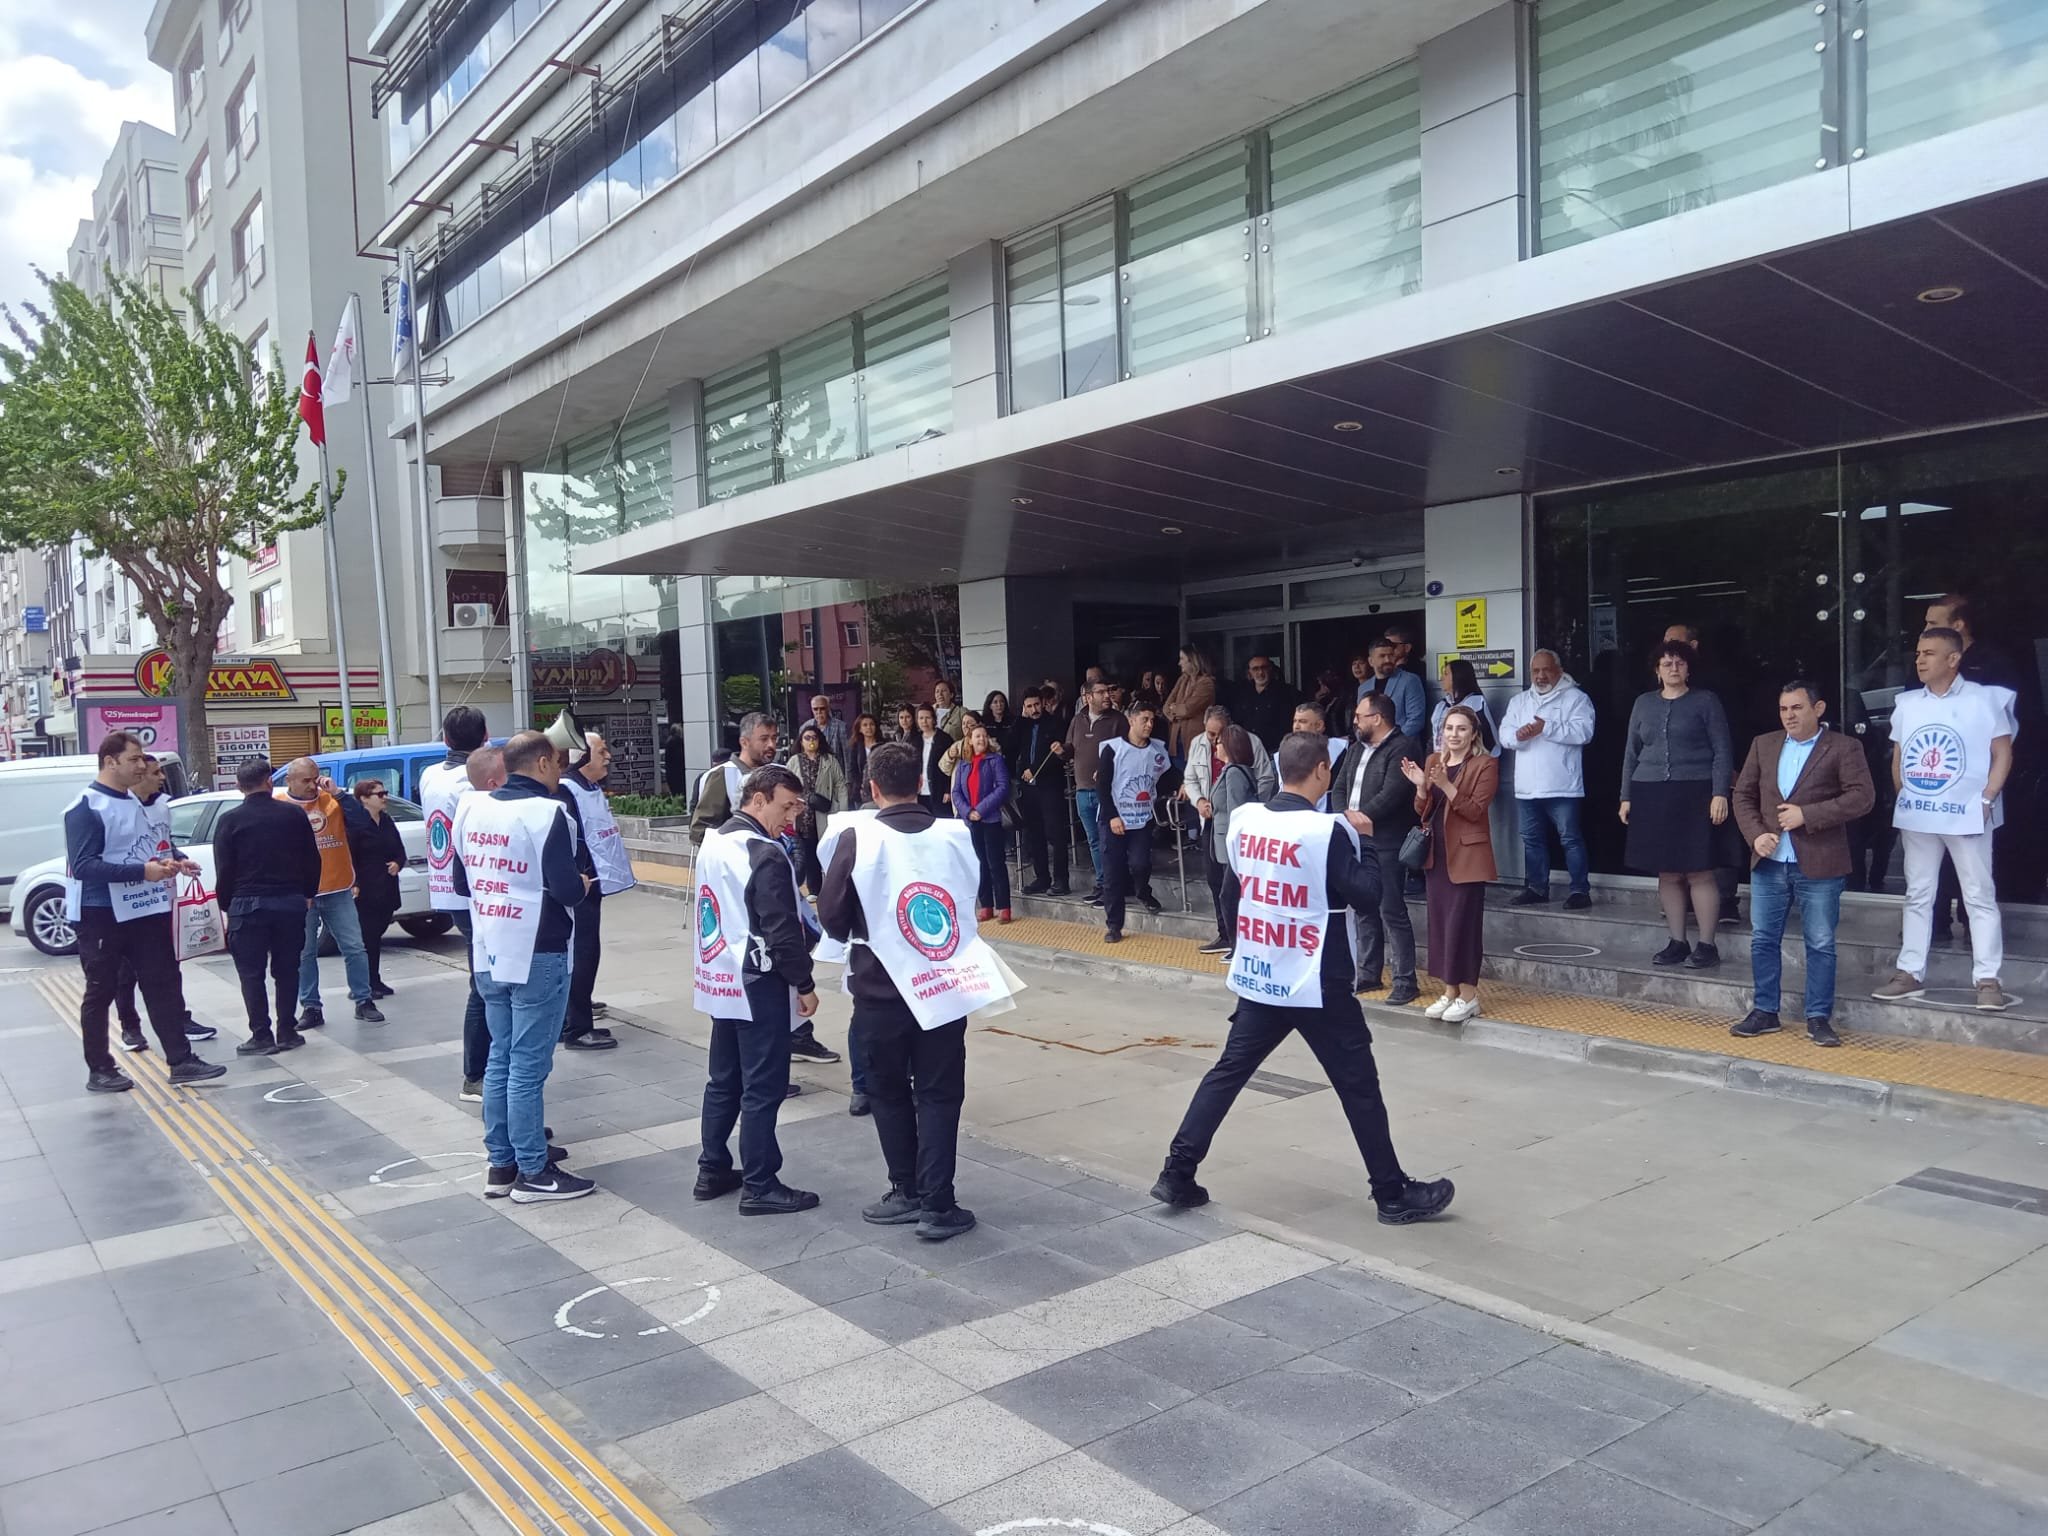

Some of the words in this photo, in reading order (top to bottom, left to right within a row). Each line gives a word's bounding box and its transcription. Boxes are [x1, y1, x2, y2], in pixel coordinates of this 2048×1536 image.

[216, 731, 231, 741] ES
[1915, 800, 1966, 815] BEL-SEN
[1239, 833, 1302, 869] EMEK
[122, 890, 150, 902] Emek
[1239, 873, 1309, 909] YLEM
[1242, 955, 1272, 979] TÜM
